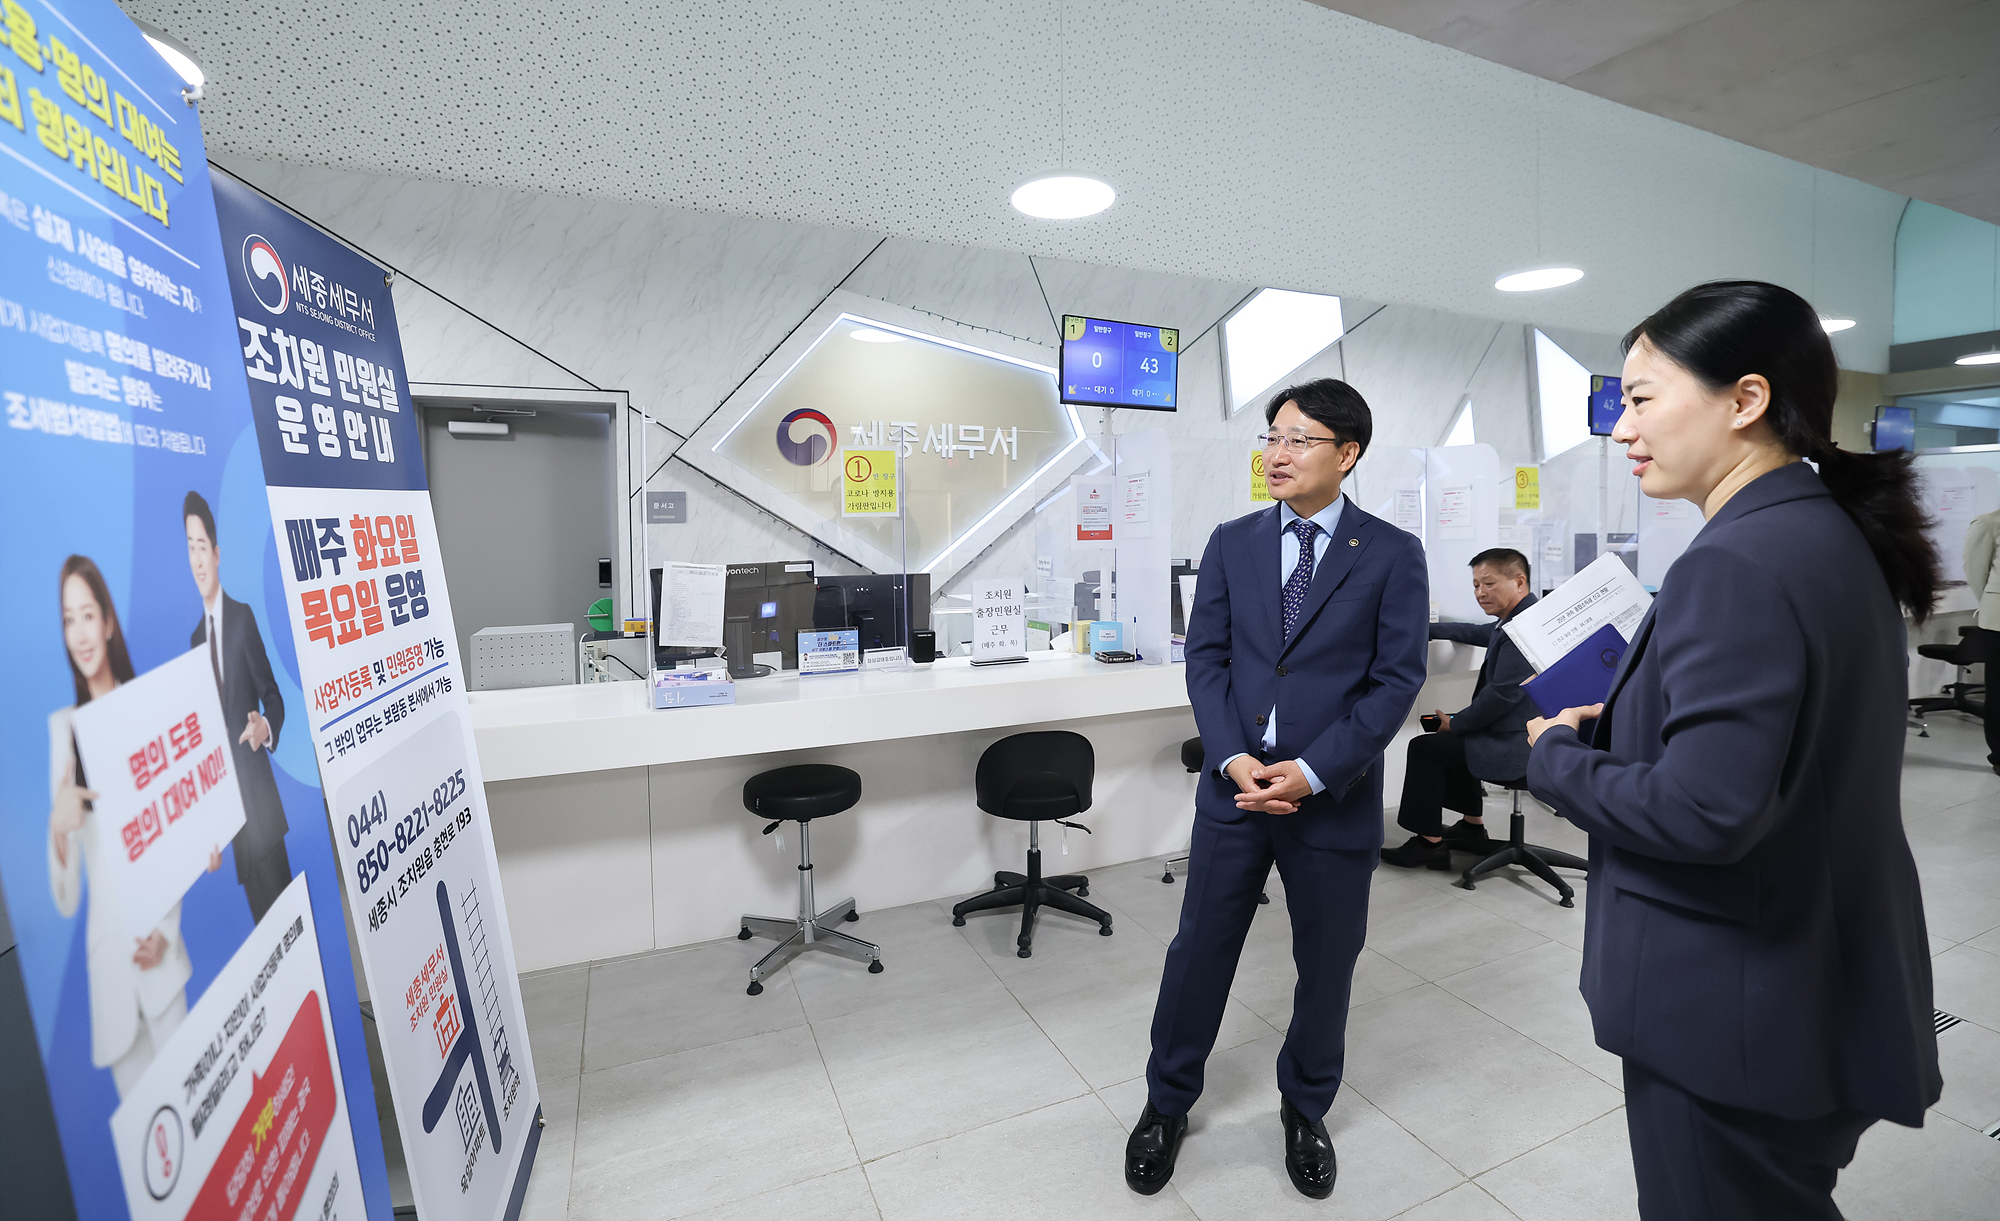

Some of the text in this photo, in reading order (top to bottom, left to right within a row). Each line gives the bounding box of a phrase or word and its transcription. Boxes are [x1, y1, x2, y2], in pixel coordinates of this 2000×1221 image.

[0, 0, 115, 130] 용·명의
[114, 90, 184, 185] 대여는
[27, 86, 170, 228] 행위입니다
[32, 203, 75, 252] 실제
[78, 228, 128, 279] 사업을
[128, 255, 181, 306] 영위하는
[292, 262, 375, 330] 세종세무서
[295, 301, 376, 343] NTS SEJONG DISTRICT OFFICE
[1070, 324, 1076, 334] 1
[1093, 325, 1112, 334] 일반창구
[1134, 330, 1152, 339] 일반창구
[1167, 336, 1173, 346] 2
[104, 329, 153, 372] 명의를
[152, 347, 212, 391] 빌려주거나
[238, 316, 400, 413] 조치원 민원실
[1092, 352, 1102, 368] 0
[1140, 357, 1159, 374] 43
[121, 374, 164, 413] 행위는
[1094, 386, 1115, 395] 대기 0
[1132, 388, 1144, 397] 대기
[1603, 399, 1615, 411] 42
[852, 420, 1018, 461] 세종세무서
[653, 502, 675, 510] 문서고
[846, 489, 895, 498] 코로나 방지용
[284, 513, 421, 583] 매주 화요일
[300, 569, 430, 650] 목요일 운영
[976, 605, 1021, 618] 출장민원실
[984, 589, 1012, 600] 조치원
[990, 624, 1009, 636] 근무
[314, 637, 445, 714] 사업자등록 및 민원증명 가능
[324, 676, 452, 764] 그 밖의 업무는 보람동 본서에서 가능
[128, 711, 203, 791] 명의 도용
[121, 800, 163, 863] 명의
[162, 771, 199, 826] 대여
[347, 789, 388, 848] 044)
[356, 768, 467, 894] 850-8221-8225
[368, 806, 472, 933] 세종시 조치원읍 충현로 193
[282, 915, 305, 954] 명의를
[404, 943, 445, 1010] 세종세무서
[409, 964, 449, 1033] 조치원 민원실
[502, 1070, 521, 1122] 조치원역
[460, 1121, 487, 1195] 욱일아파트
